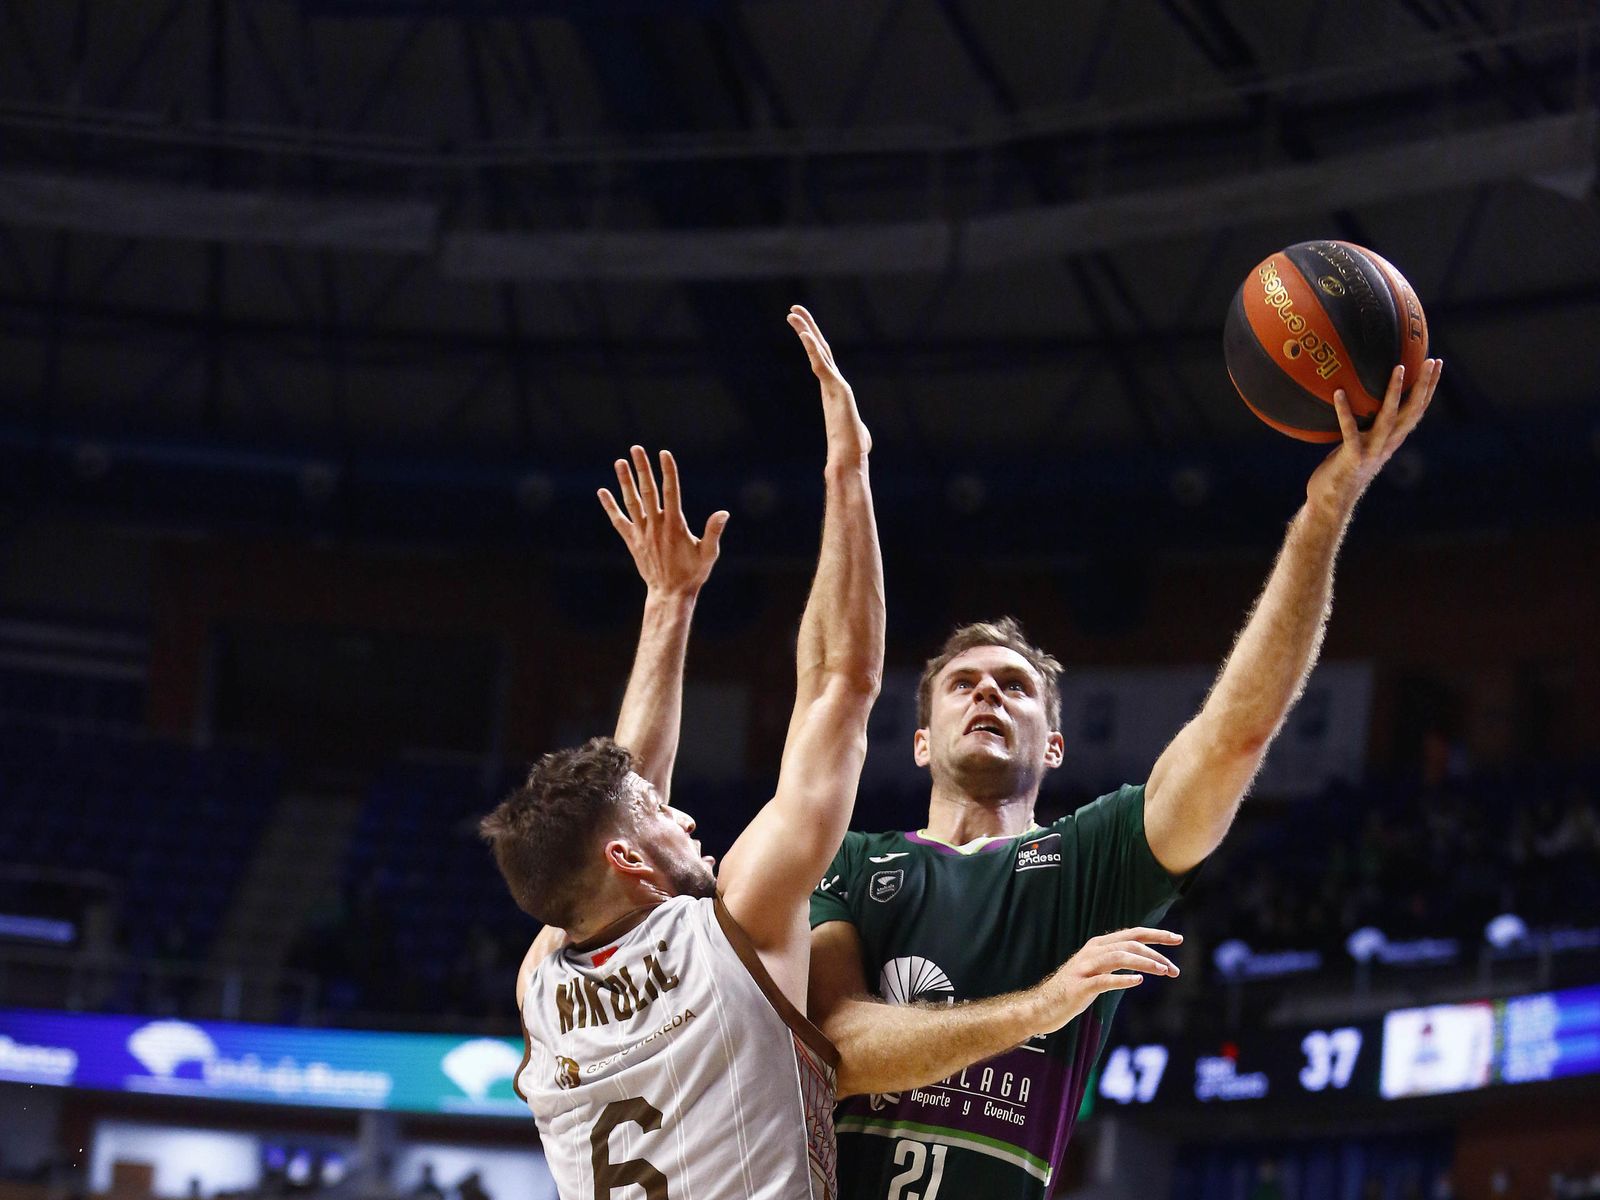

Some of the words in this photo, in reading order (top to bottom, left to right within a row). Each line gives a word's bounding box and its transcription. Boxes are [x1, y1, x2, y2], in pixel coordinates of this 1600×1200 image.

[1018, 854, 1061, 866] endesa
[1299, 1026, 1363, 1091] 37
[911, 1087, 951, 1108] Deporte
[962, 1100, 972, 1116] y
[984, 1101, 1026, 1126] Eventos
